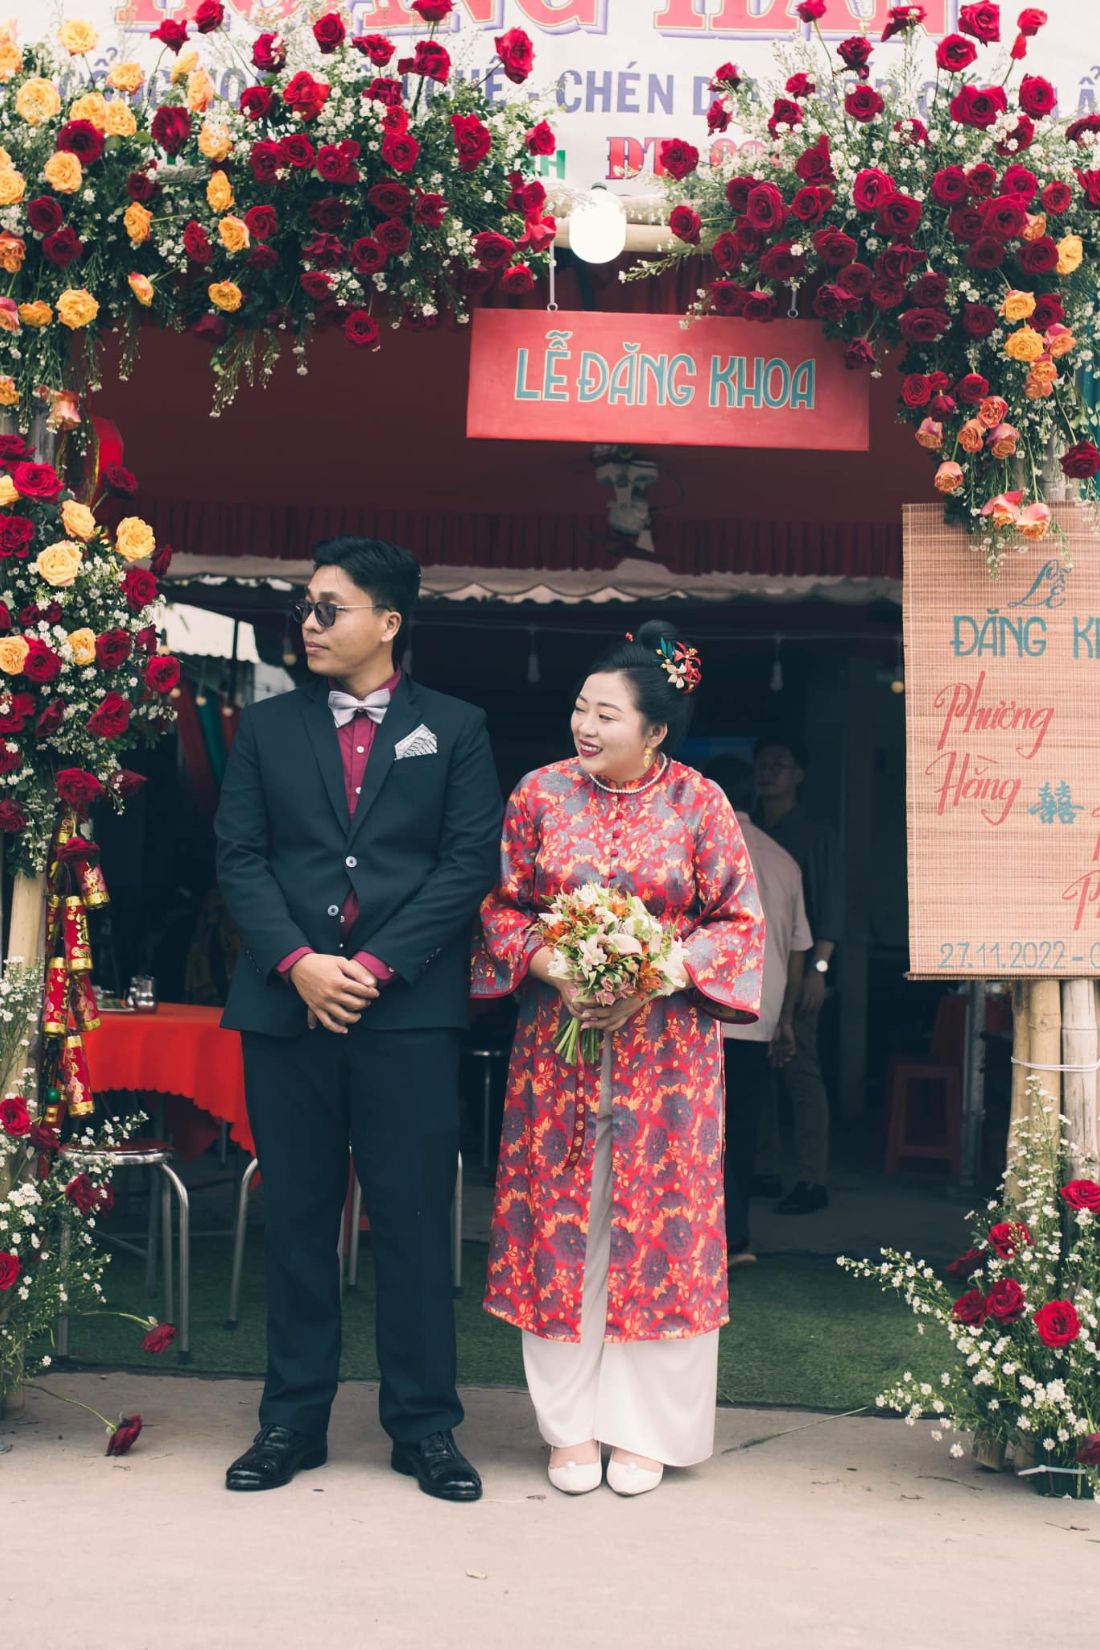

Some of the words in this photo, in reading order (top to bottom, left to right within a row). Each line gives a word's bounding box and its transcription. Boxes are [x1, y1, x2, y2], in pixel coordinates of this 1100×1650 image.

[556, 61, 675, 115] CHÉN
[514, 331, 573, 402] LỄ
[576, 342, 697, 406] ĐĂNG
[708, 355, 817, 410] KHOA
[950, 608, 1047, 657] ĐĂNG
[925, 751, 1022, 825] Hằng
